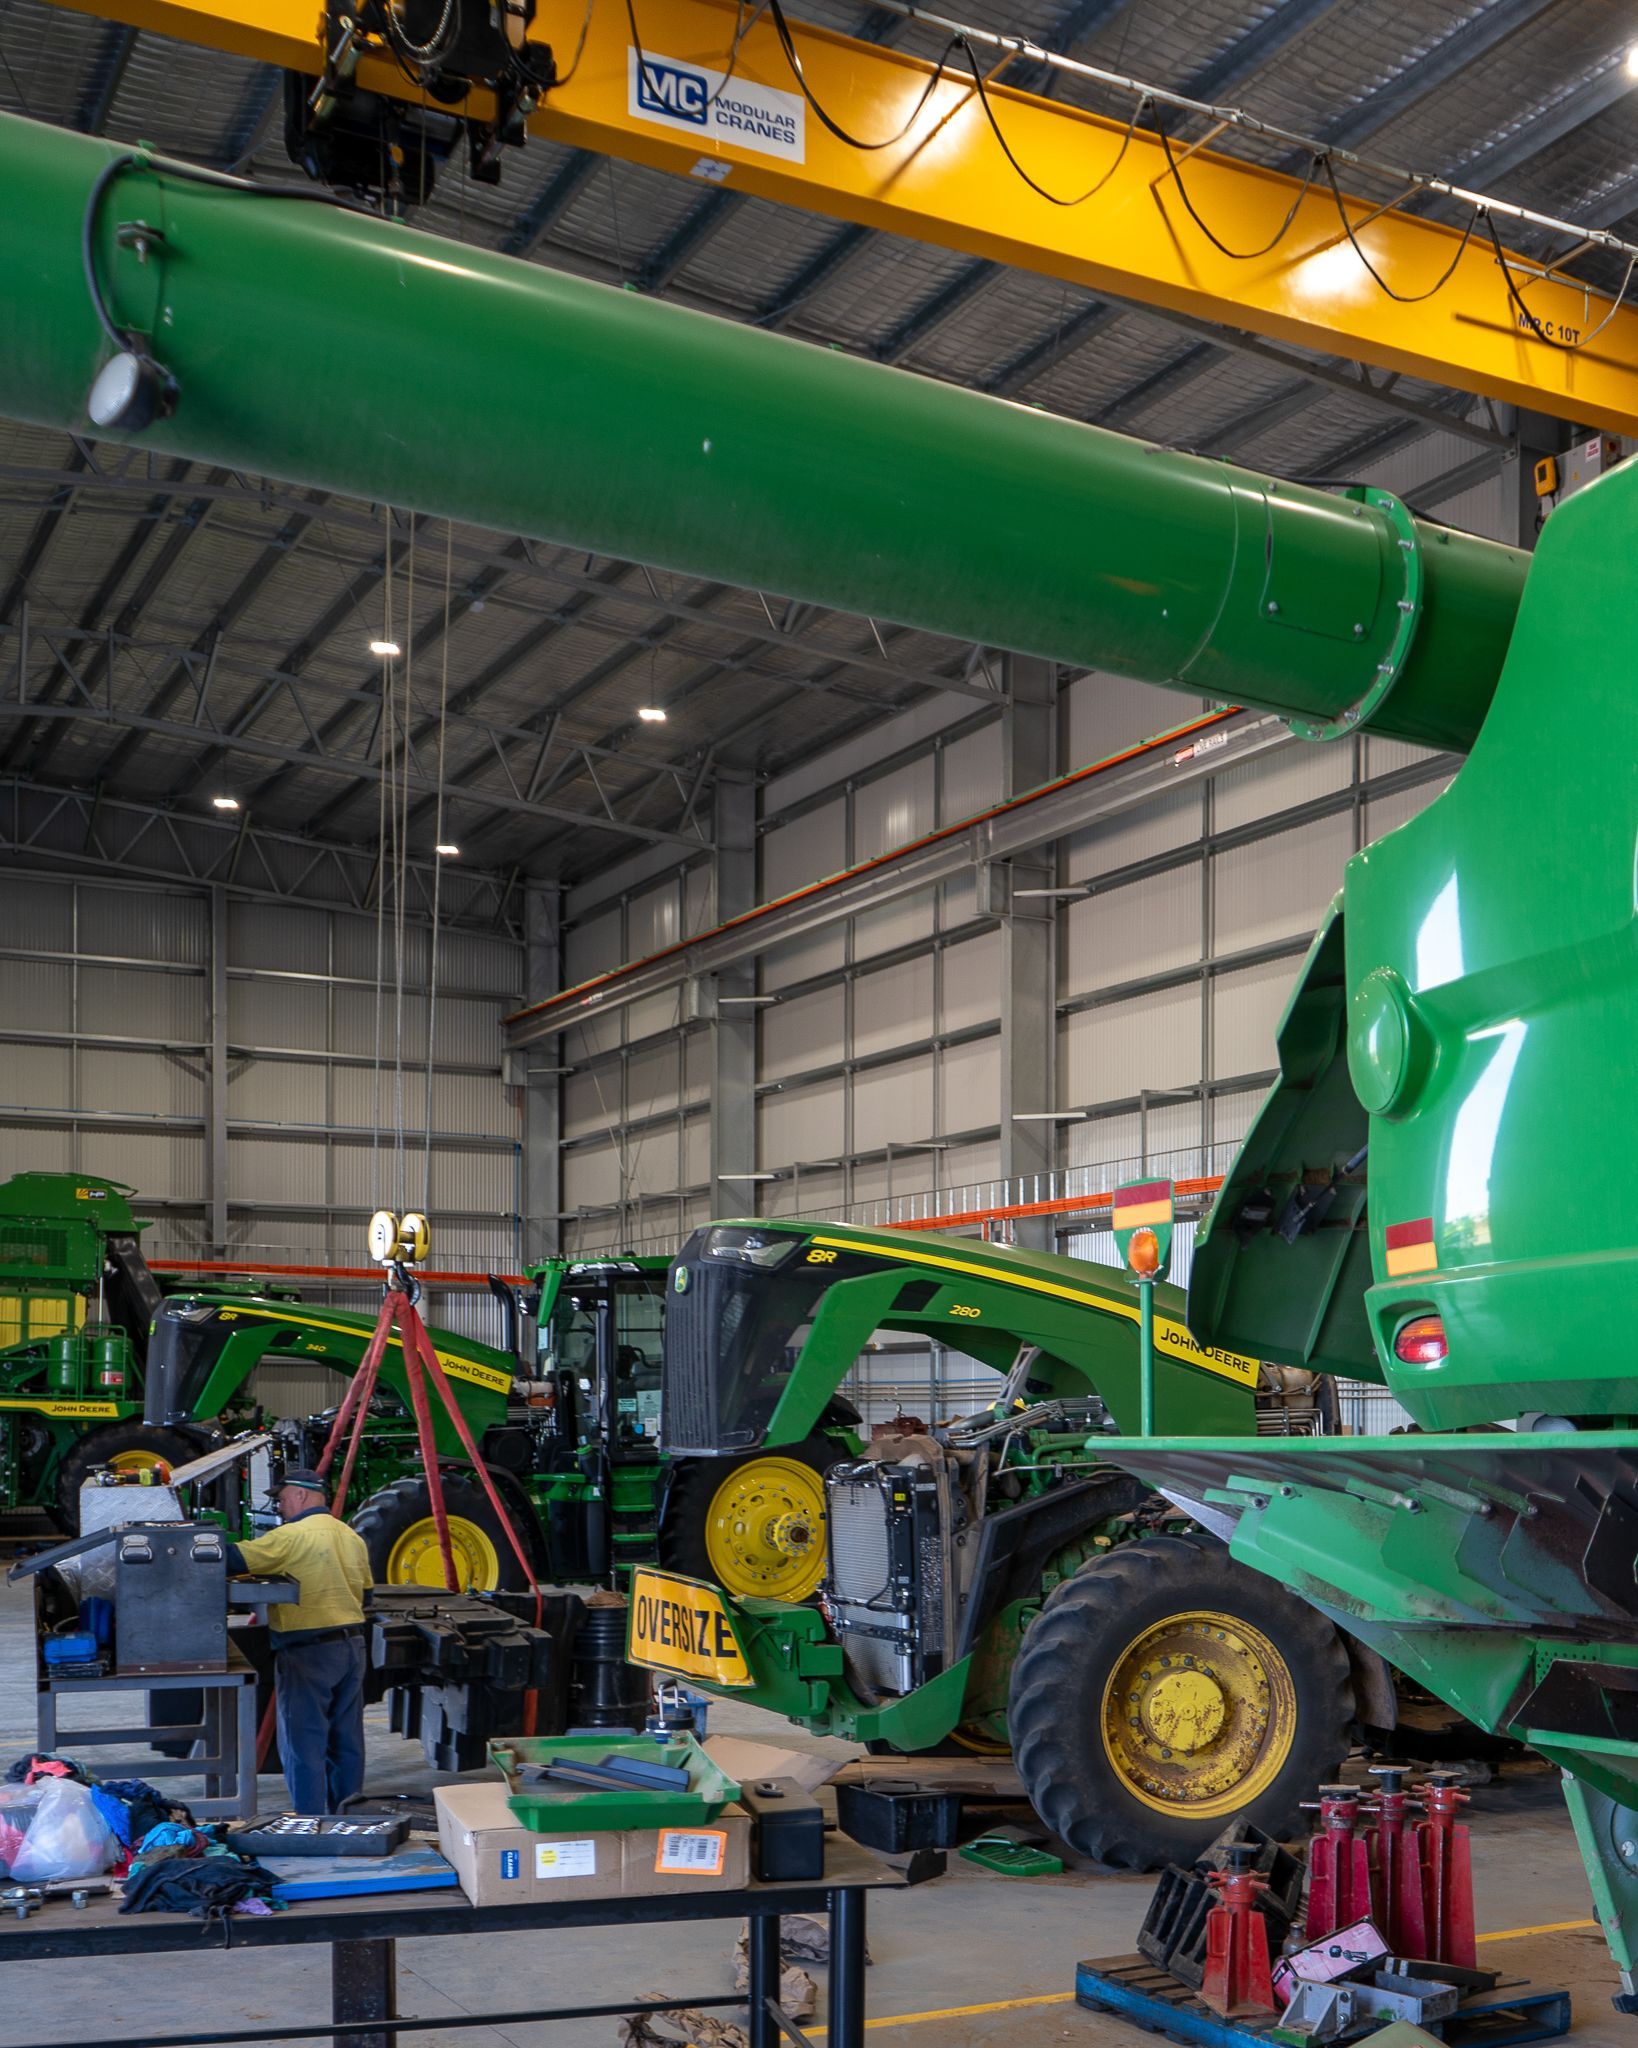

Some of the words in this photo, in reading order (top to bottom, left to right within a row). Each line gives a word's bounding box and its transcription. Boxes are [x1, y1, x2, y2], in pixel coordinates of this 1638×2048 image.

[642, 67, 703, 112] MC
[714, 96, 796, 129] MODULAR
[715, 111, 796, 144] CRANES
[1558, 325, 1580, 344] 10T
[806, 1249, 837, 1263] 8R
[949, 1304, 981, 1318] 280
[1160, 1328, 1200, 1353] JOHN
[1204, 1346, 1251, 1374] DEERE
[442, 1359, 470, 1374] JOHN
[471, 1368, 505, 1387] DEERE
[79, 1405, 111, 1413] DEERE
[637, 1595, 738, 1658] OVERSIZE
